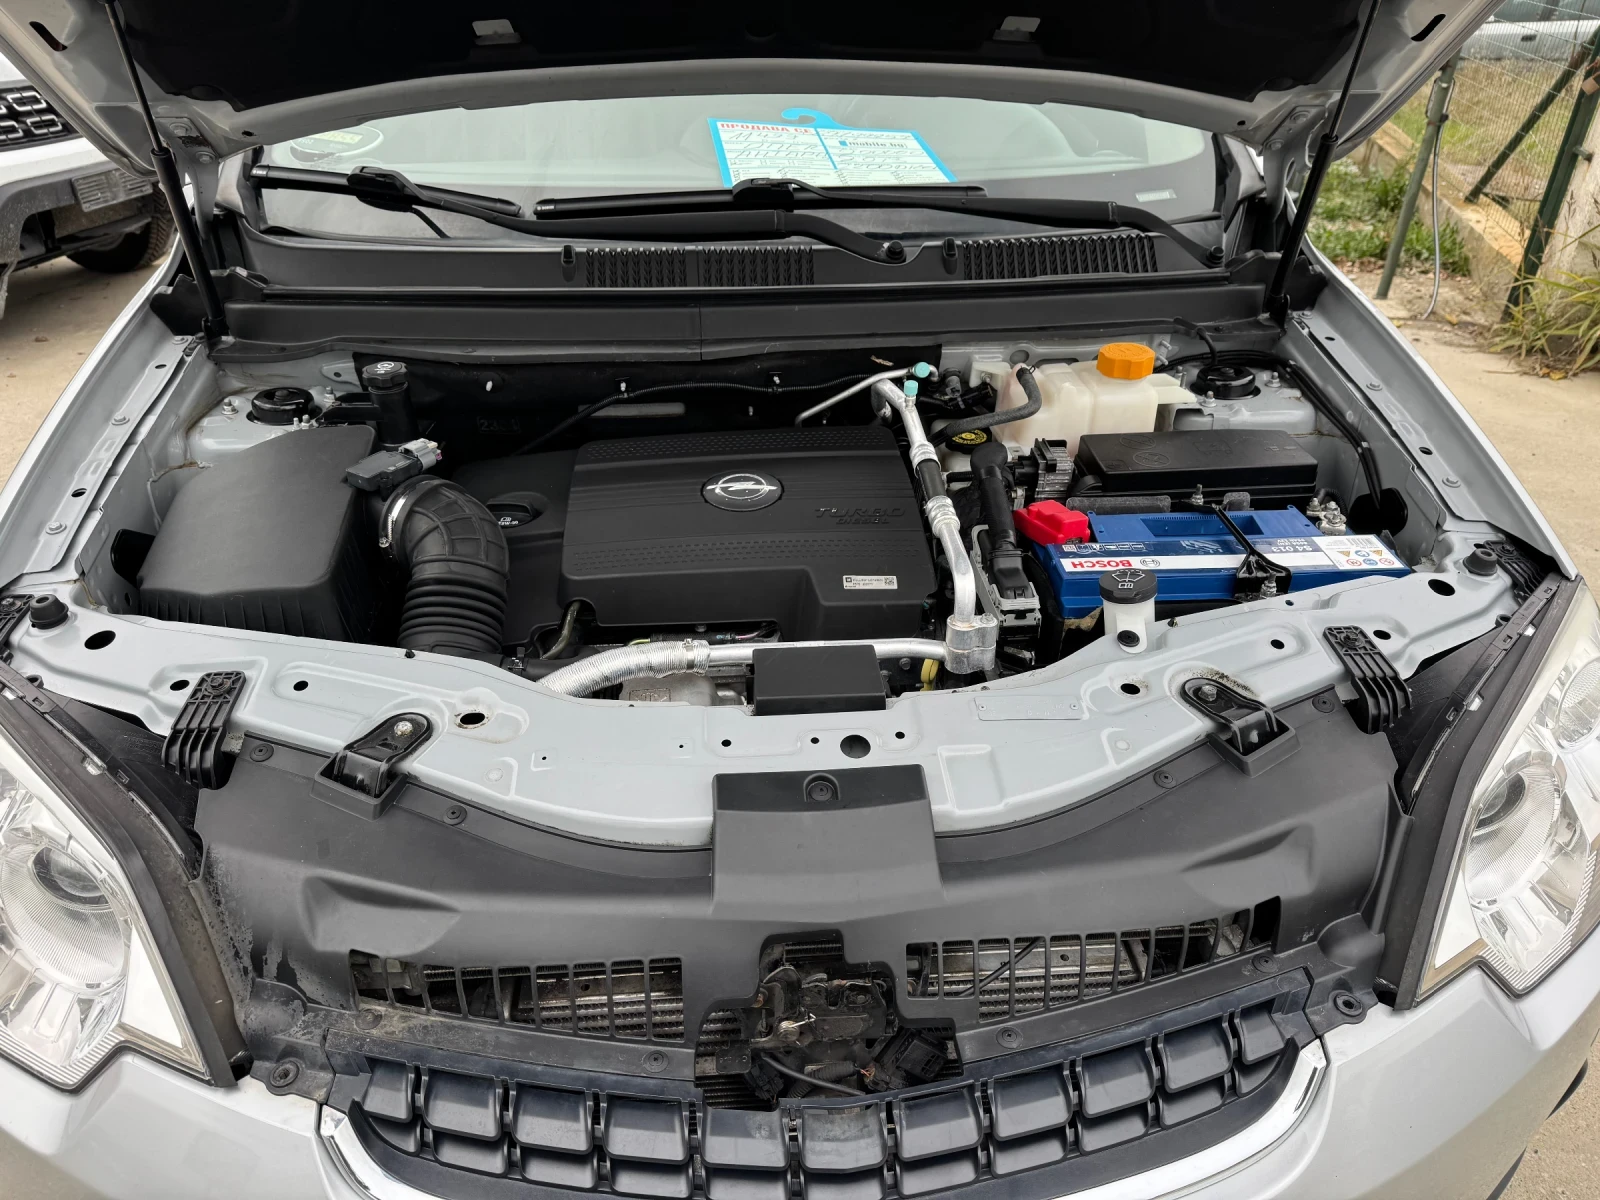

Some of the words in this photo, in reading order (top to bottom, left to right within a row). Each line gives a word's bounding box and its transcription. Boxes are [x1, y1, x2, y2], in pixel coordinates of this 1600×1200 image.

[720, 123, 791, 133] ПРОДАВА
[814, 507, 906, 518] TURBO
[1071, 560, 1133, 569] BOSCH
